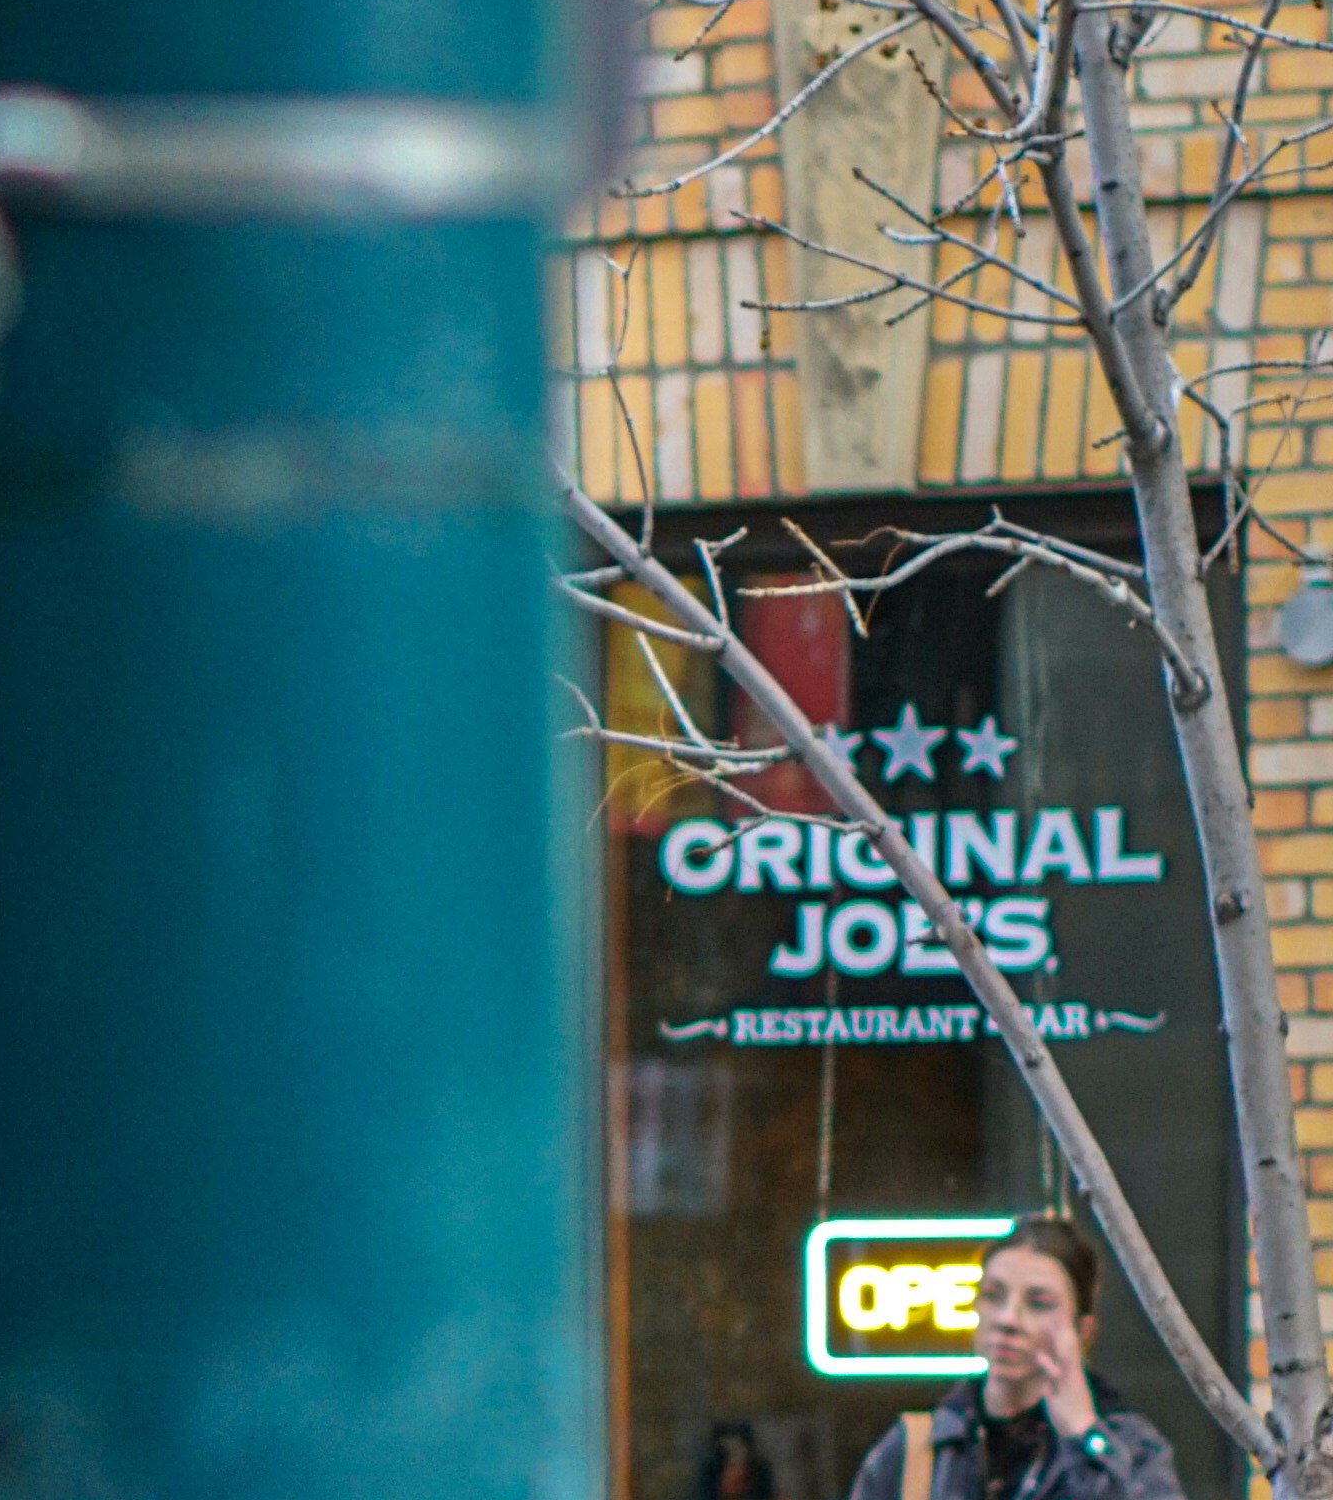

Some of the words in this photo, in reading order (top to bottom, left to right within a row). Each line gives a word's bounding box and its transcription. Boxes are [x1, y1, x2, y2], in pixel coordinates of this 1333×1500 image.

[660, 805, 1164, 894] ORIGINAL
[769, 897, 1053, 977] JOE'S
[732, 1005, 980, 1044] RESTAURANT
[1020, 1002, 1089, 1039] AR
[839, 1263, 985, 1332] OPE
